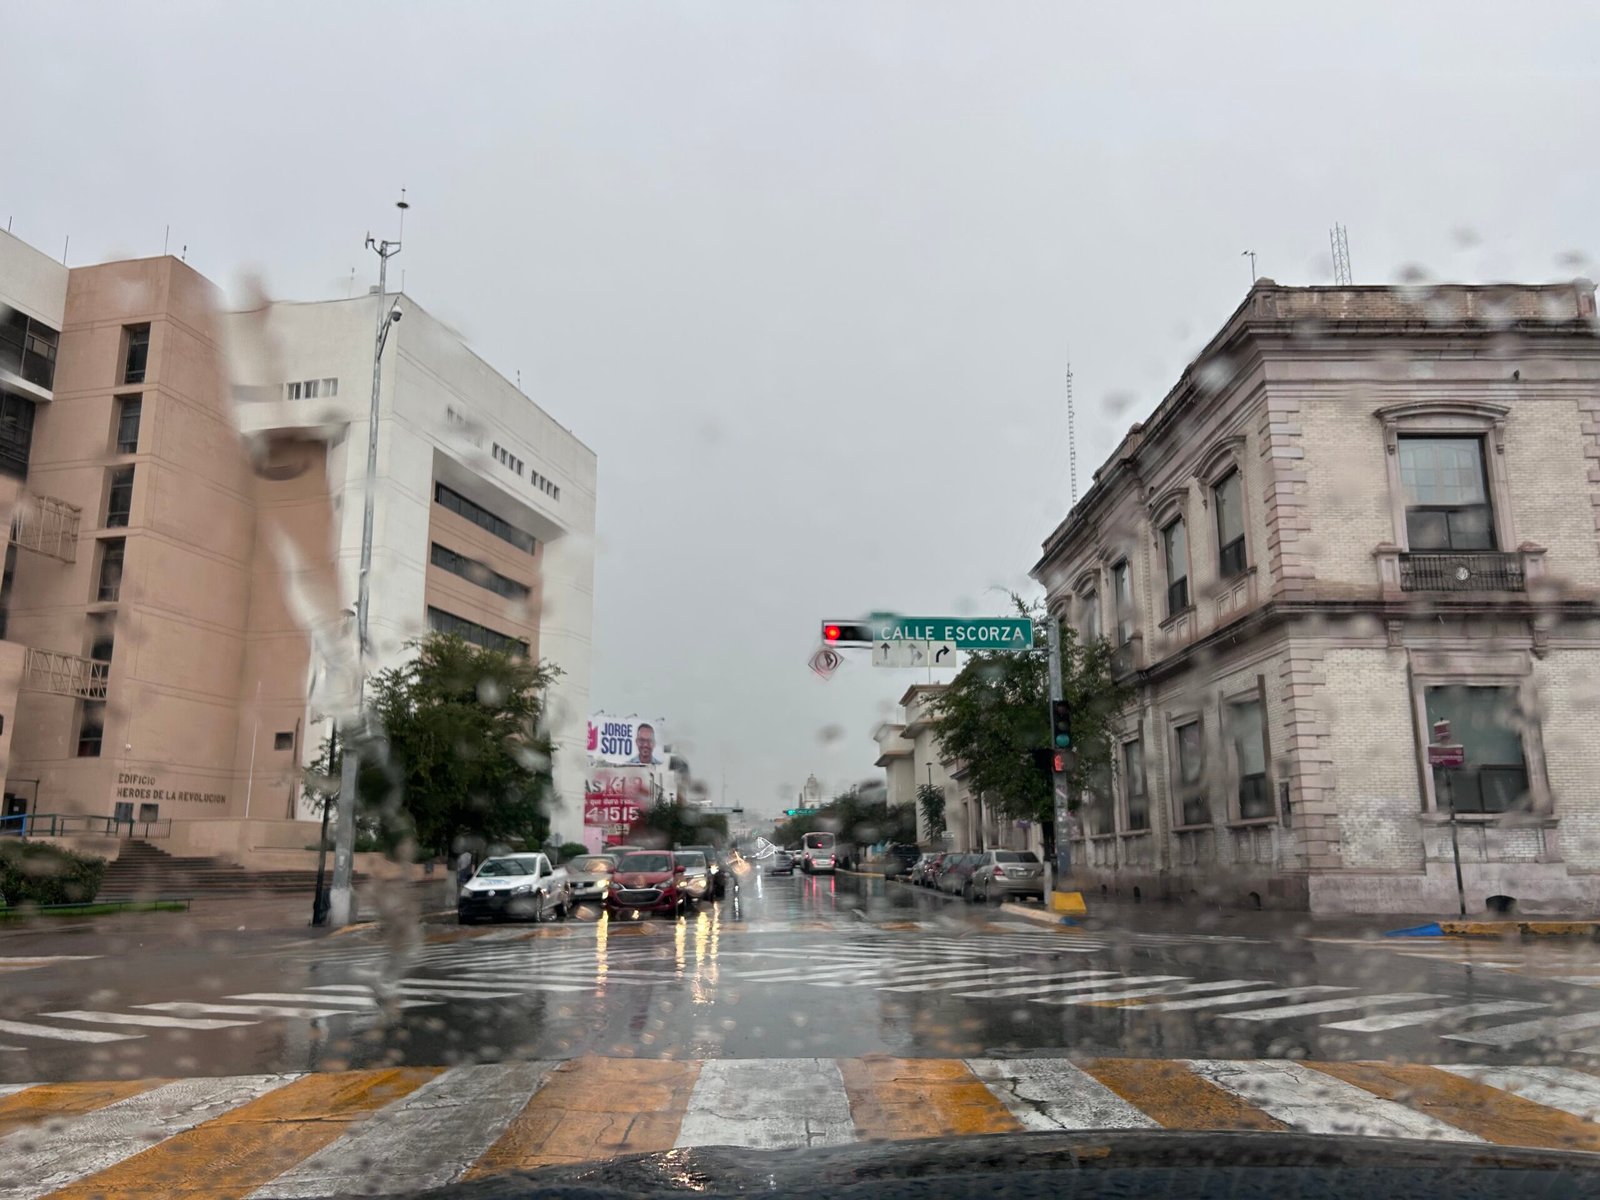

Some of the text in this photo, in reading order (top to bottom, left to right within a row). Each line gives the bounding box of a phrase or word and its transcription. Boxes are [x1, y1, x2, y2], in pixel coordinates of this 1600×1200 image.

[880, 626, 1025, 641] CALLE ESCORZA
[601, 722, 633, 738] JORGE
[601, 737, 633, 756] SOTO
[118, 773, 156, 786] EDIFICIO
[116, 787, 226, 804] HEROES DE LA REVOLUCION
